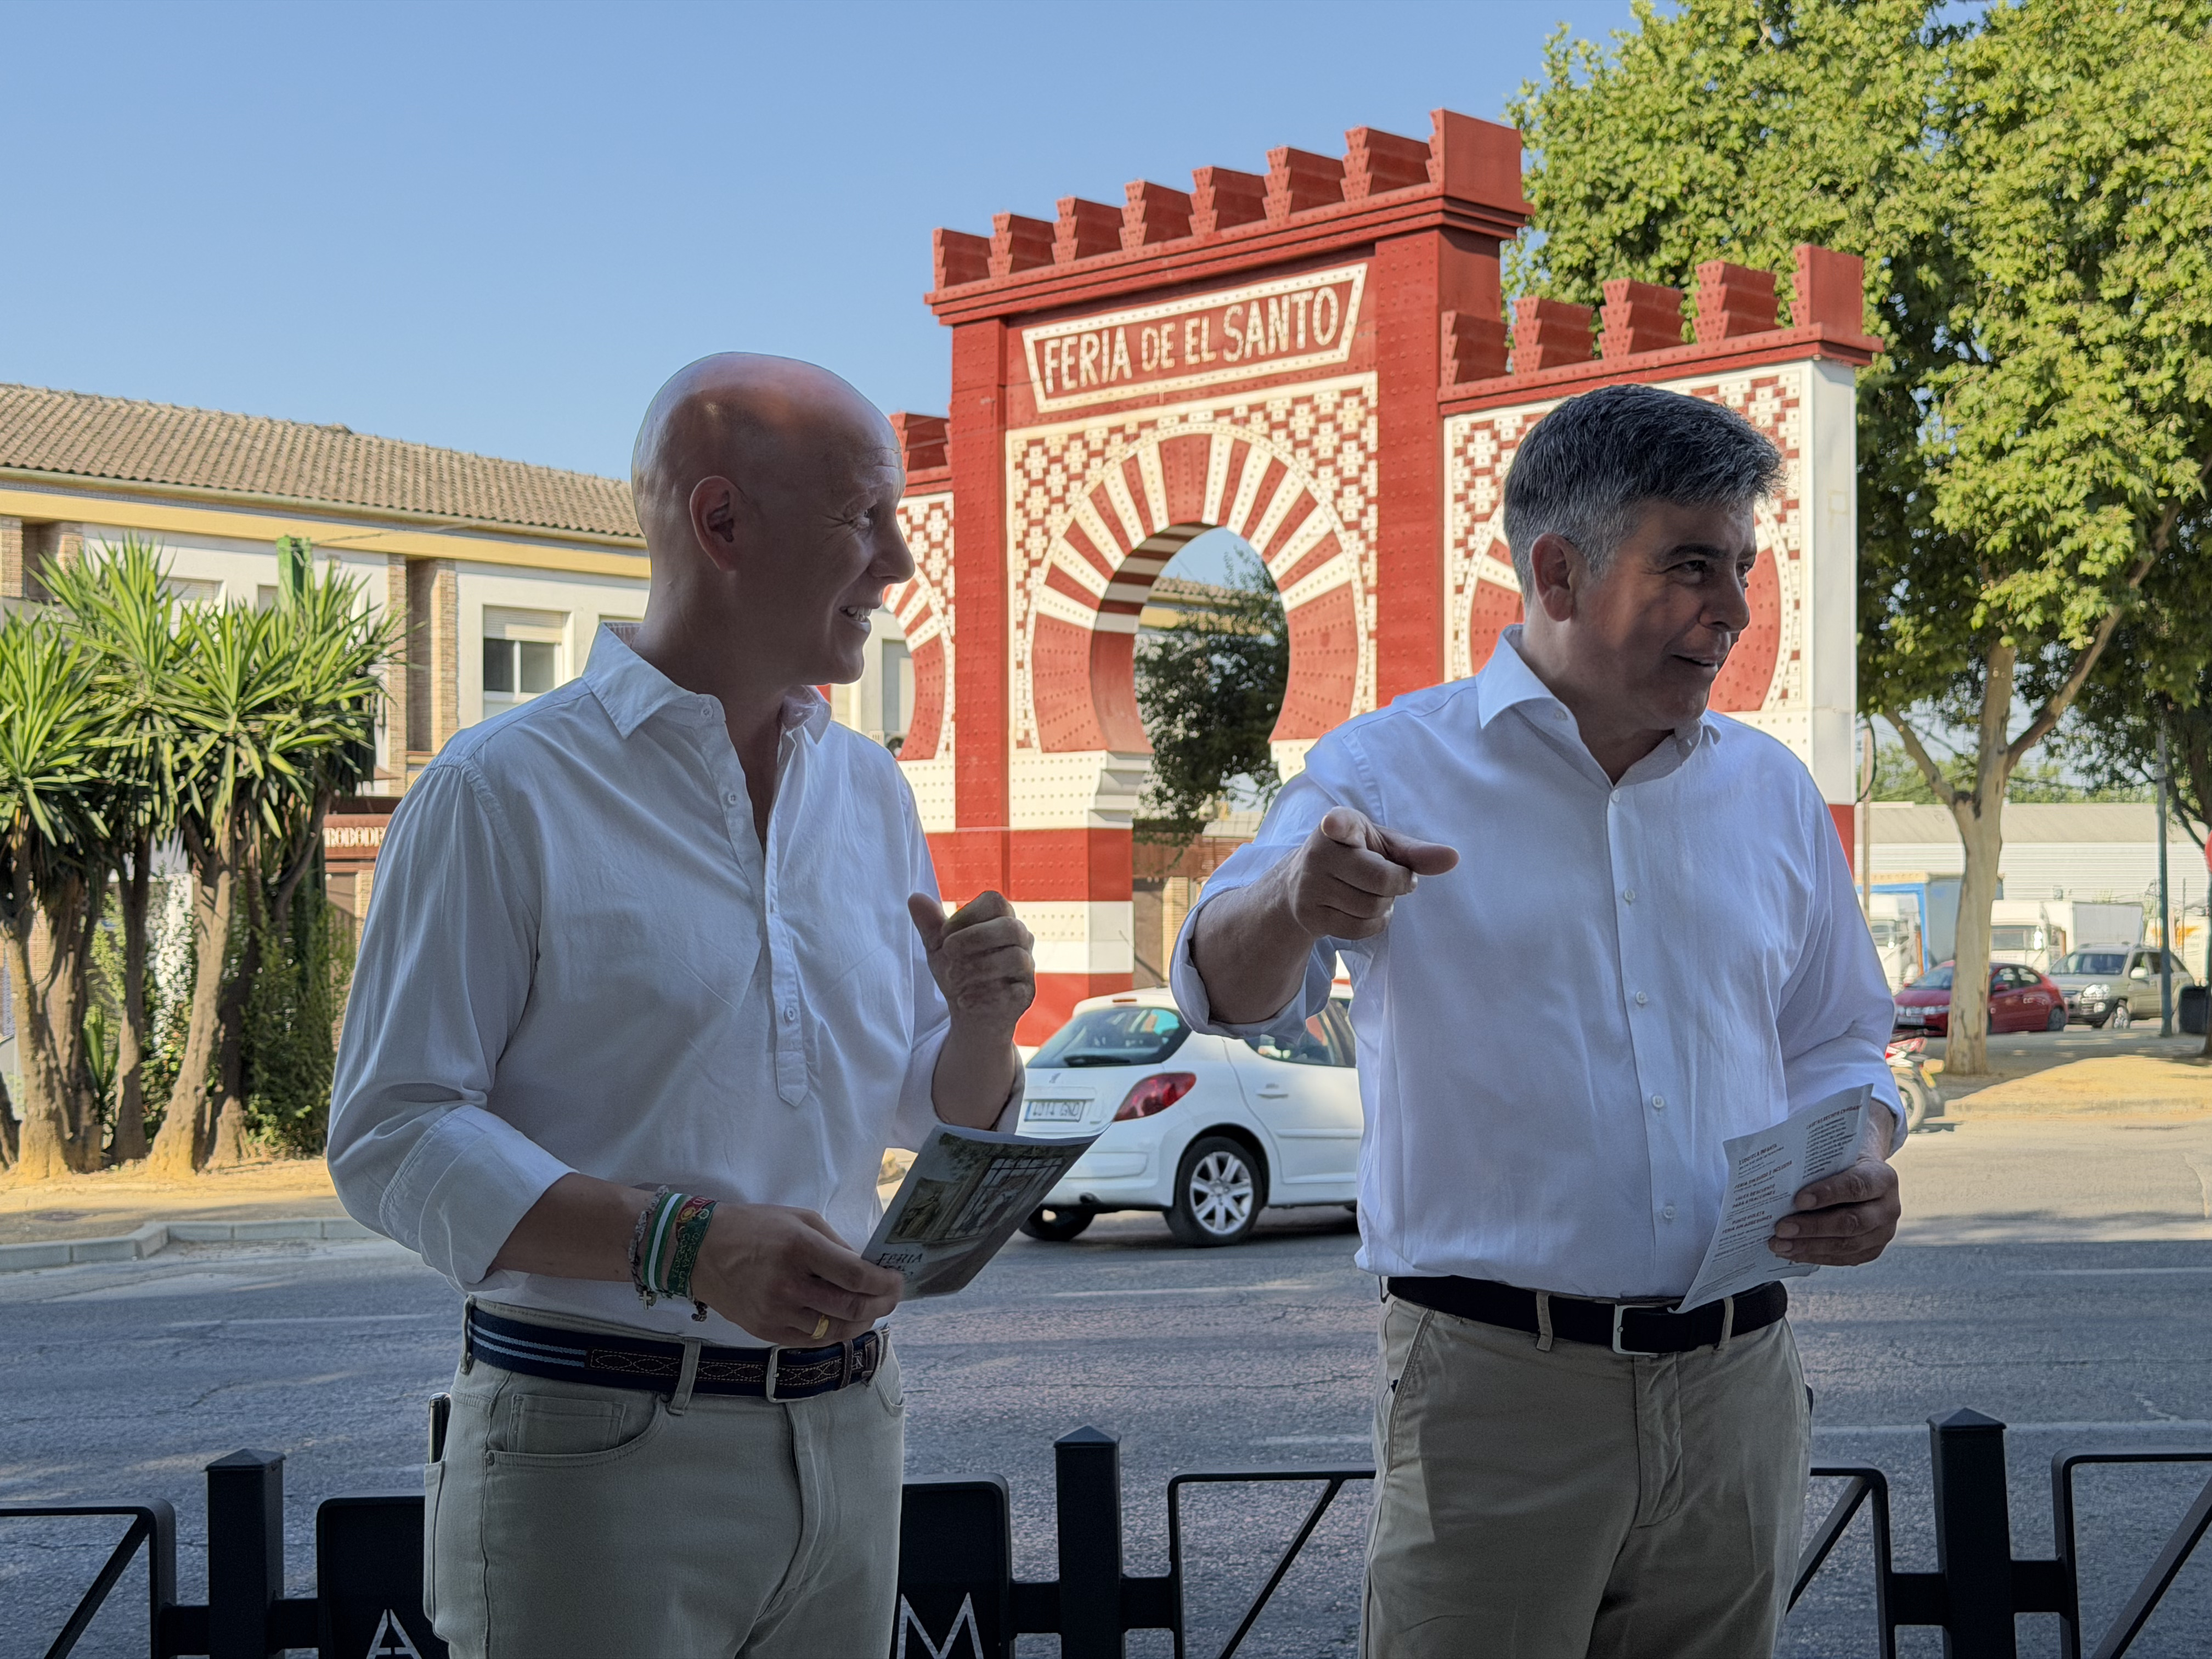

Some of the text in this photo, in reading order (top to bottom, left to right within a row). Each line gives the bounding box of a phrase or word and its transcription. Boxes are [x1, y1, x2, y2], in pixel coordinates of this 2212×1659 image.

[1045, 287, 1339, 393] FERIA DE EL SANTO
[876, 1252, 923, 1266] FERIA
[896, 1592, 984, 1659] M
